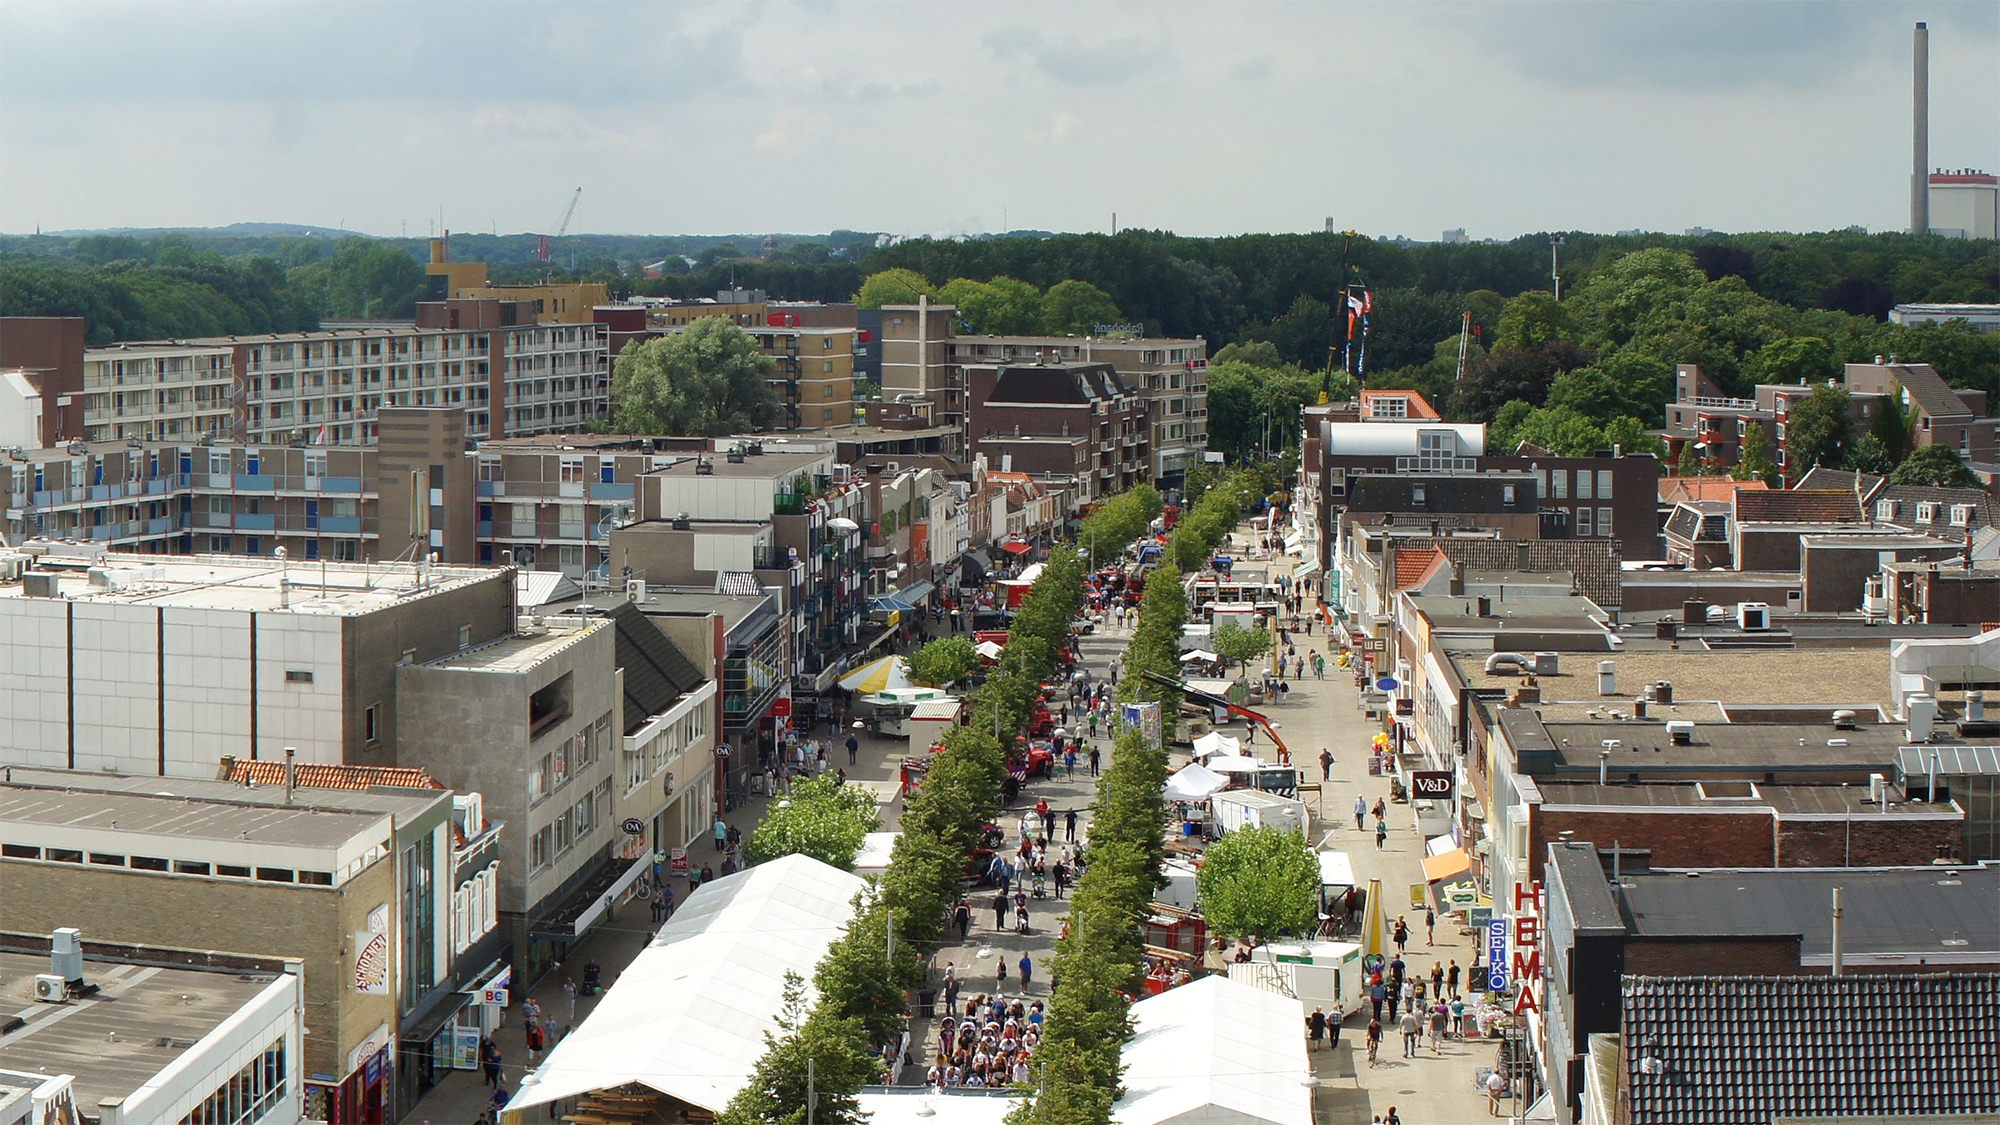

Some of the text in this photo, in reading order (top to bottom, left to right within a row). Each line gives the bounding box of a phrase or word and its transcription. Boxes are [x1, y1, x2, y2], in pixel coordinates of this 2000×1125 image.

[1364, 640, 1384, 650] WE
[1416, 778, 1450, 792] V&D
[356, 935, 387, 989] SCHOENEN
[1490, 922, 1505, 979] SEIKO
[1513, 881, 1540, 1014] HEMA
